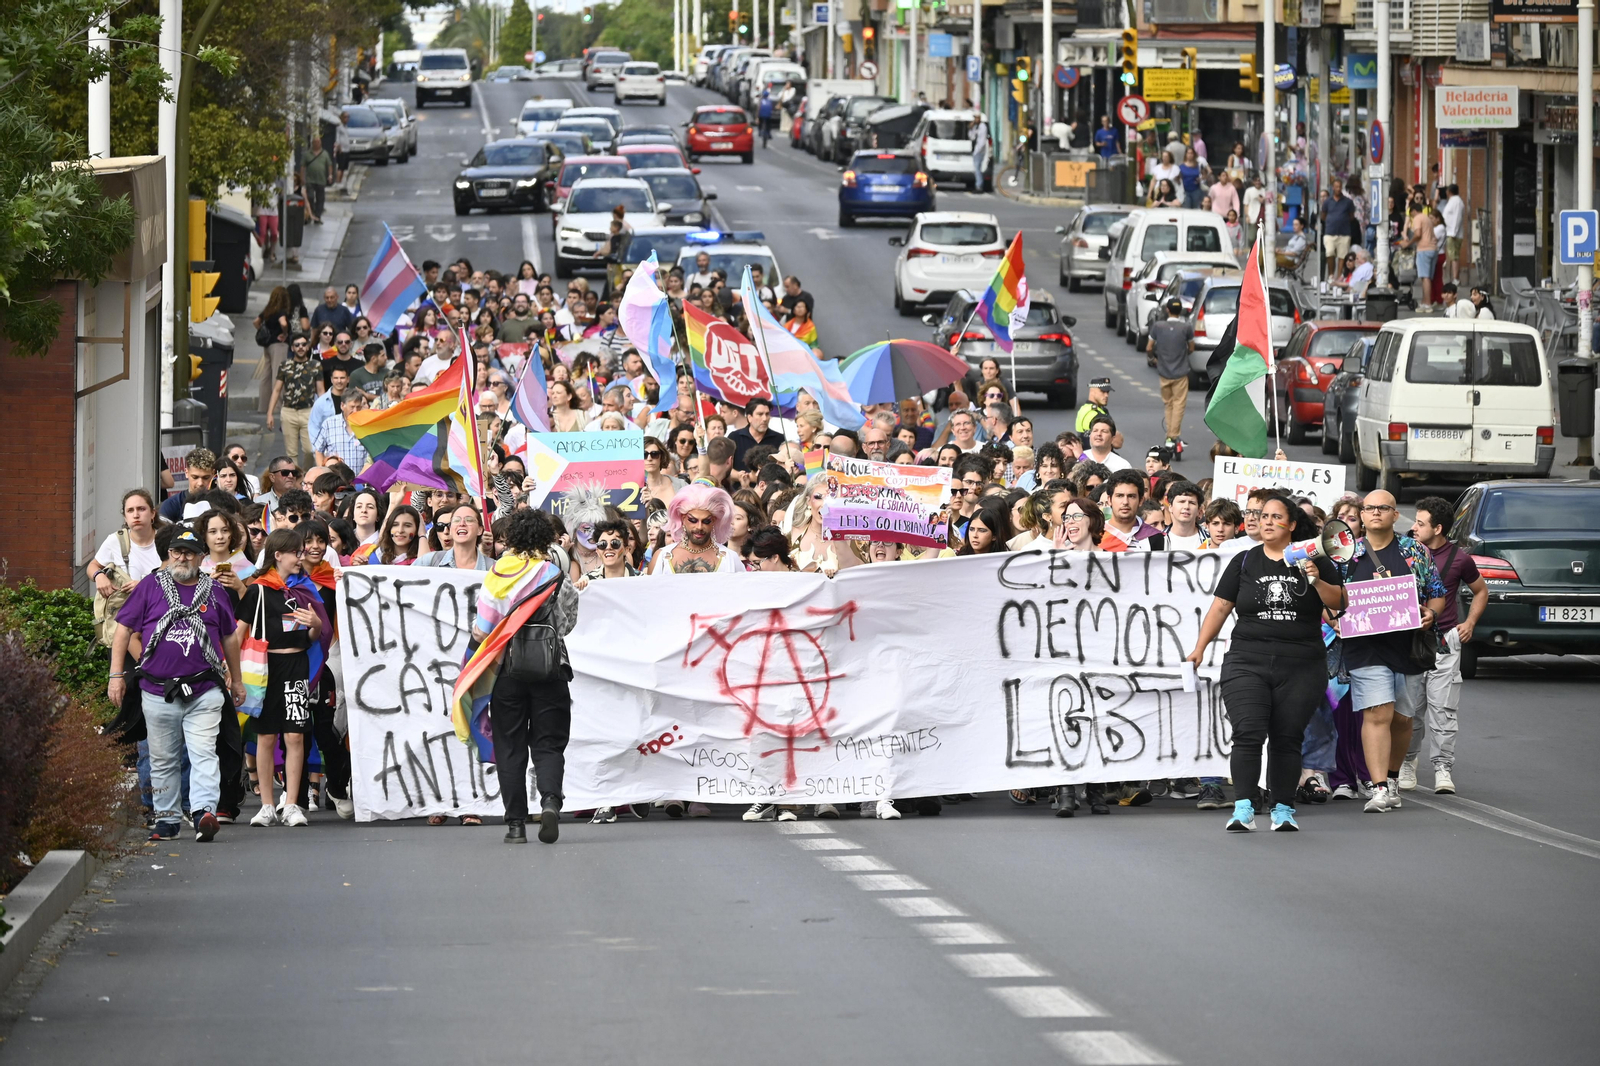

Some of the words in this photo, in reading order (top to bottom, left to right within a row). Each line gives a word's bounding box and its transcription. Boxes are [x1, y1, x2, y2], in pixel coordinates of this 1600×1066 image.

[1446, 91, 1508, 102] Heladeria
[1442, 105, 1512, 117] Valenciana
[1567, 217, 1589, 258] P
[710, 330, 760, 381] UGT
[591, 439, 605, 450] ES
[1505, 441, 1512, 450] E
[604, 468, 628, 476] SOMOS
[1223, 462, 1239, 474] EL
[1243, 464, 1305, 481] ORGULLO
[1312, 469, 1332, 484] ES
[617, 482, 640, 512] 2
[876, 499, 920, 515] LESBIANA
[840, 515, 869, 529] LET'S
[876, 516, 890, 530] GO
[998, 549, 1221, 596] CENTRO
[1259, 575, 1278, 583] WEAR
[1279, 575, 1299, 584] BLACK
[1347, 589, 1359, 597] OY
[1361, 584, 1396, 595] MARCHO
[1398, 581, 1414, 589] POR
[1358, 595, 1395, 606] MAÑANA
[1396, 592, 1409, 600] NO
[1368, 605, 1393, 615] ESTOY
[1548, 608, 1556, 620] H
[1562, 608, 1594, 620] 8231
[636, 725, 684, 757] FDO:
[680, 748, 755, 774] VAGOS,
[806, 774, 886, 797] SOCIALES
